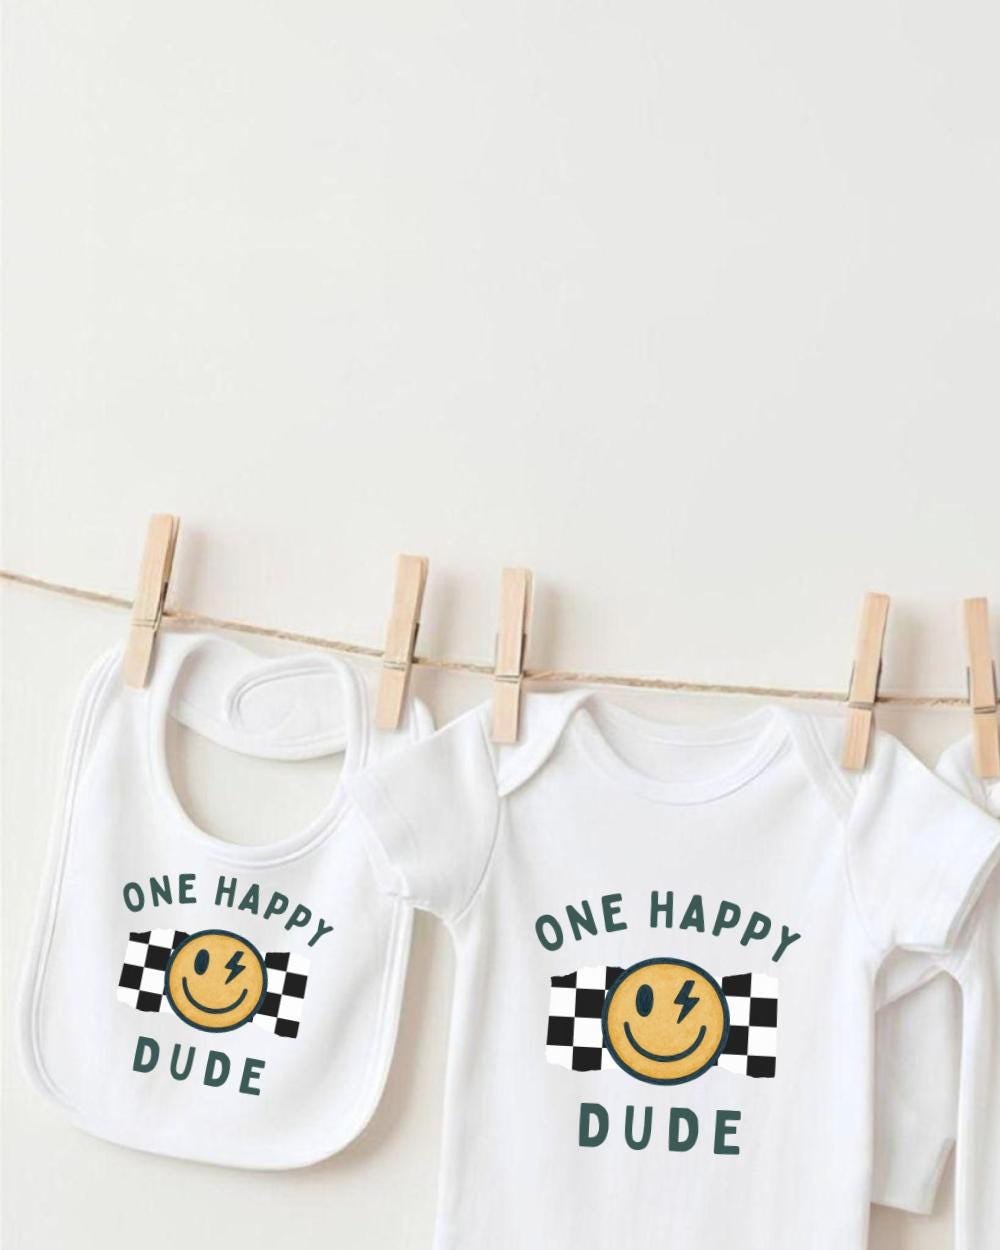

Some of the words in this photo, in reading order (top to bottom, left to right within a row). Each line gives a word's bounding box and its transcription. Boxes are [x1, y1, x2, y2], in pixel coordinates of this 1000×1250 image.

[123, 873, 197, 913] ONE
[214, 876, 334, 948] HAPPY
[534, 893, 628, 952] ONE
[650, 890, 802, 962] HAPPY
[132, 1035, 265, 1096] DUDE
[578, 1103, 741, 1156] DUDE
